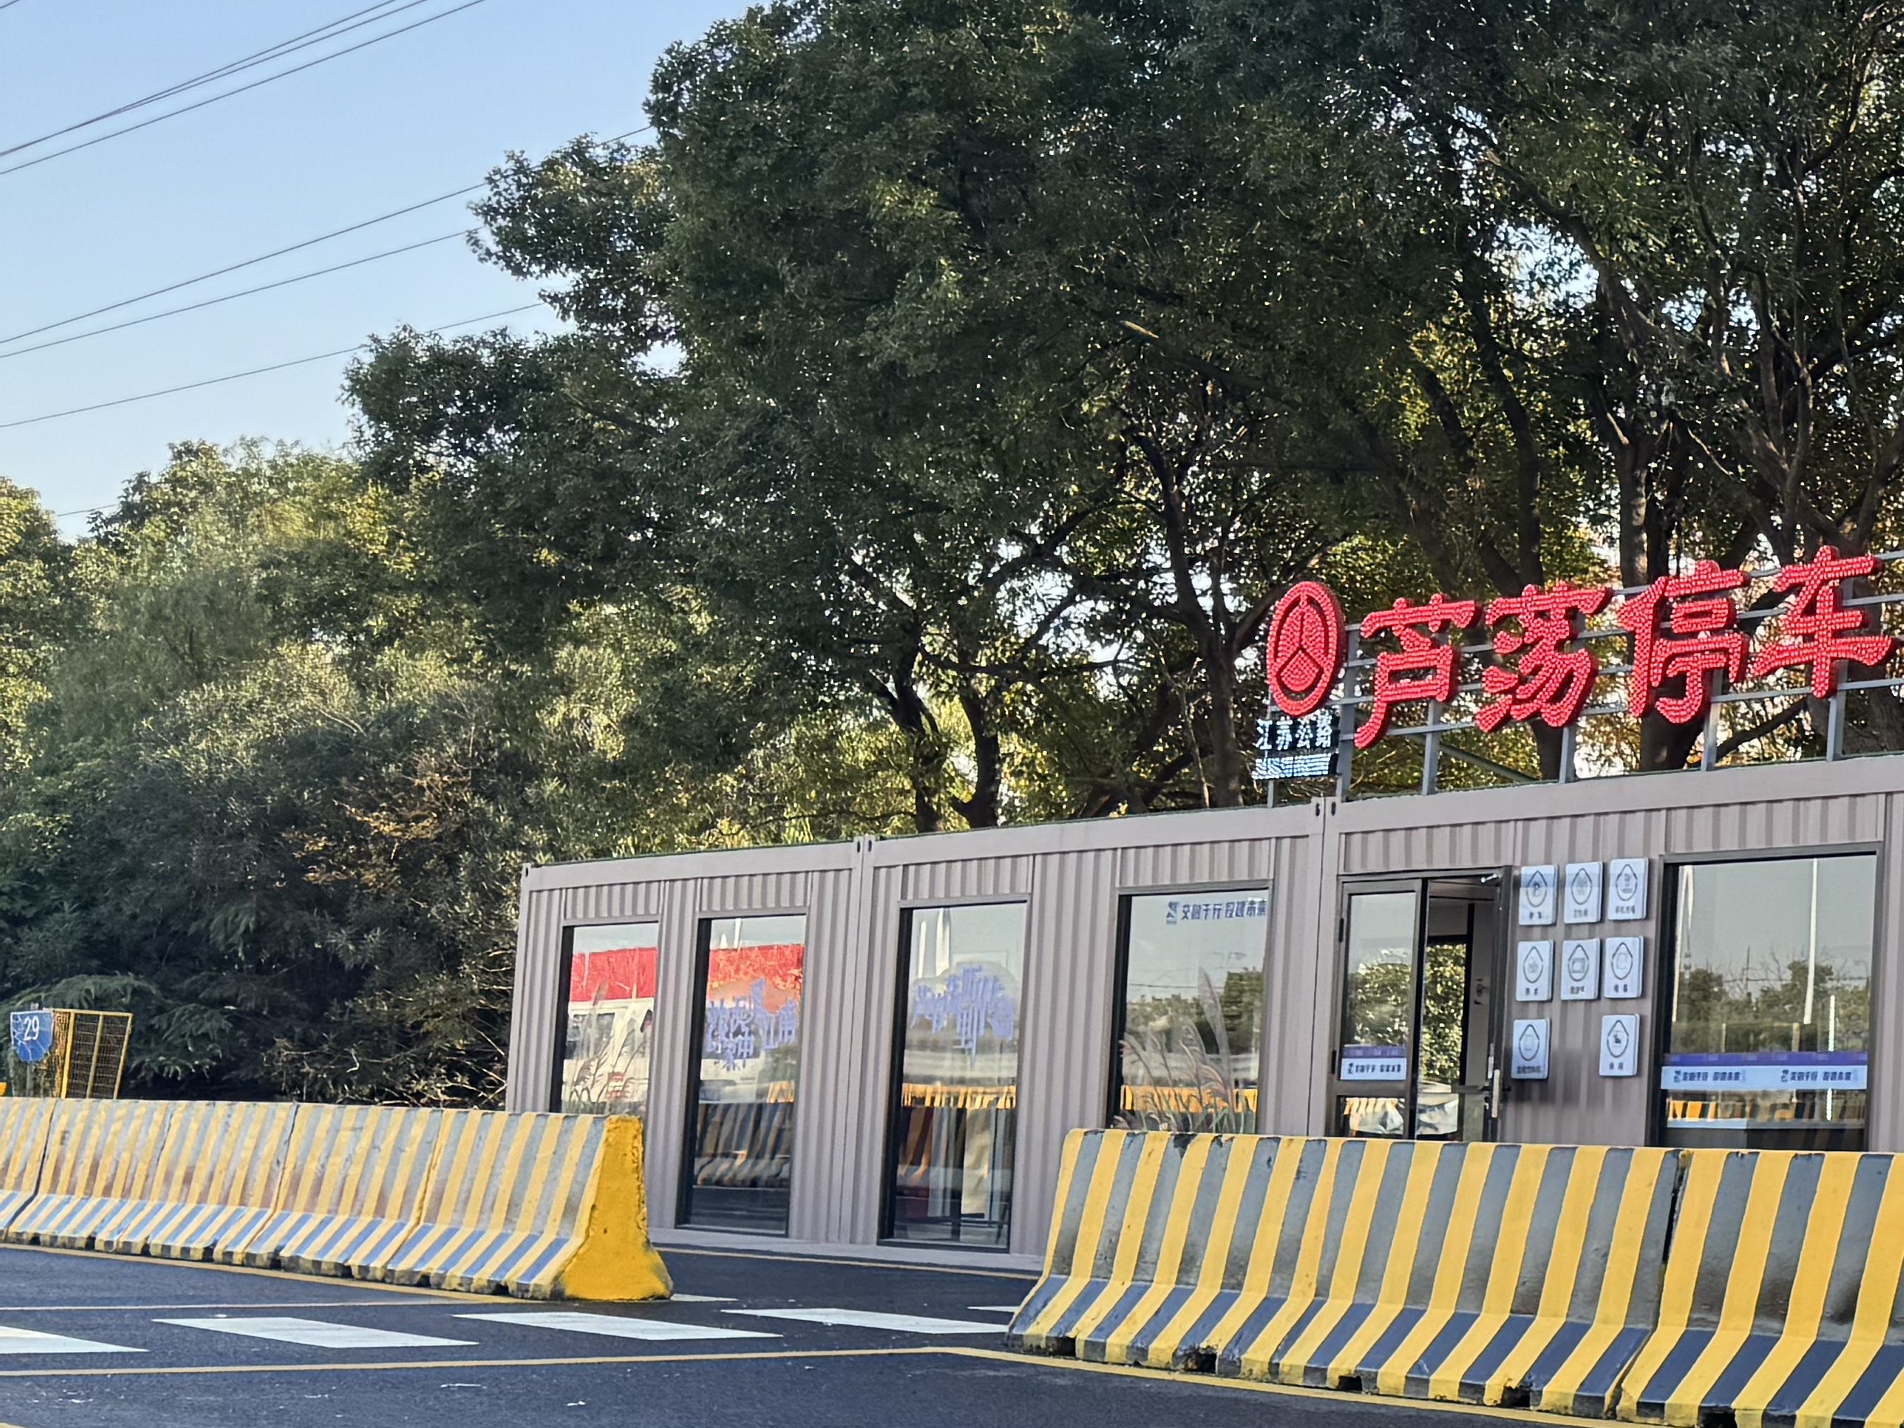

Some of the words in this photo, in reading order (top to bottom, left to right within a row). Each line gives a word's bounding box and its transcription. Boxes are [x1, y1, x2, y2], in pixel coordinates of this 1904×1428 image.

[1253, 709, 1332, 750] 江苏公路
[23, 1015, 40, 1041] 29
